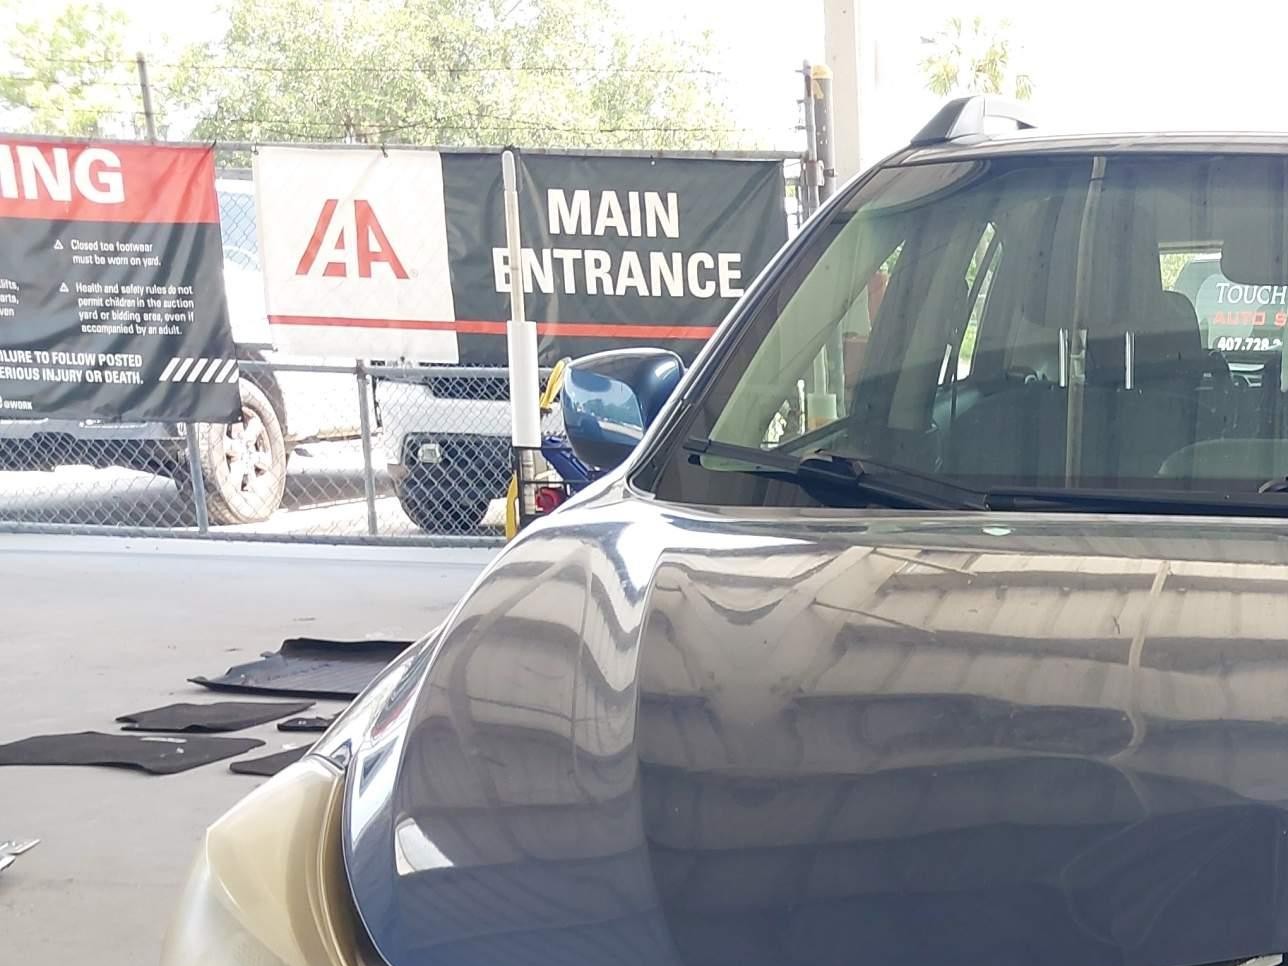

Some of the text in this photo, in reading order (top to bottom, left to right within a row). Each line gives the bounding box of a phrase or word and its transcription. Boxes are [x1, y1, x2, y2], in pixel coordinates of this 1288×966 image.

[547, 188, 680, 238] MAIN
[71, 240, 153, 253] Closed toe footwear
[73, 254, 93, 265] must
[95, 254, 105, 265] be
[108, 256, 129, 266] worn
[130, 257, 141, 266] on
[492, 246, 745, 298] ENTRANCE
[75, 282, 193, 296] Health and safety rules do not
[1216, 282, 1287, 305] TOUCH
[78, 297, 104, 308] permit
[105, 297, 136, 307] children
[137, 298, 145, 307] in
[147, 298, 162, 308] the
[78, 310, 99, 321] yard
[101, 312, 110, 321] or
[112, 311, 141, 323] bidding
[165, 314, 184, 323] even
[186, 312, 194, 322] if
[81, 325, 183, 336] accompanied by an adult.
[34, 351, 49, 364] TO
[51, 352, 96, 366] FOLLOW
[98, 353, 143, 368] POSTED
[42, 368, 82, 382] INJURY
[85, 370, 102, 383] OR
[104, 370, 144, 385] DEATH.
